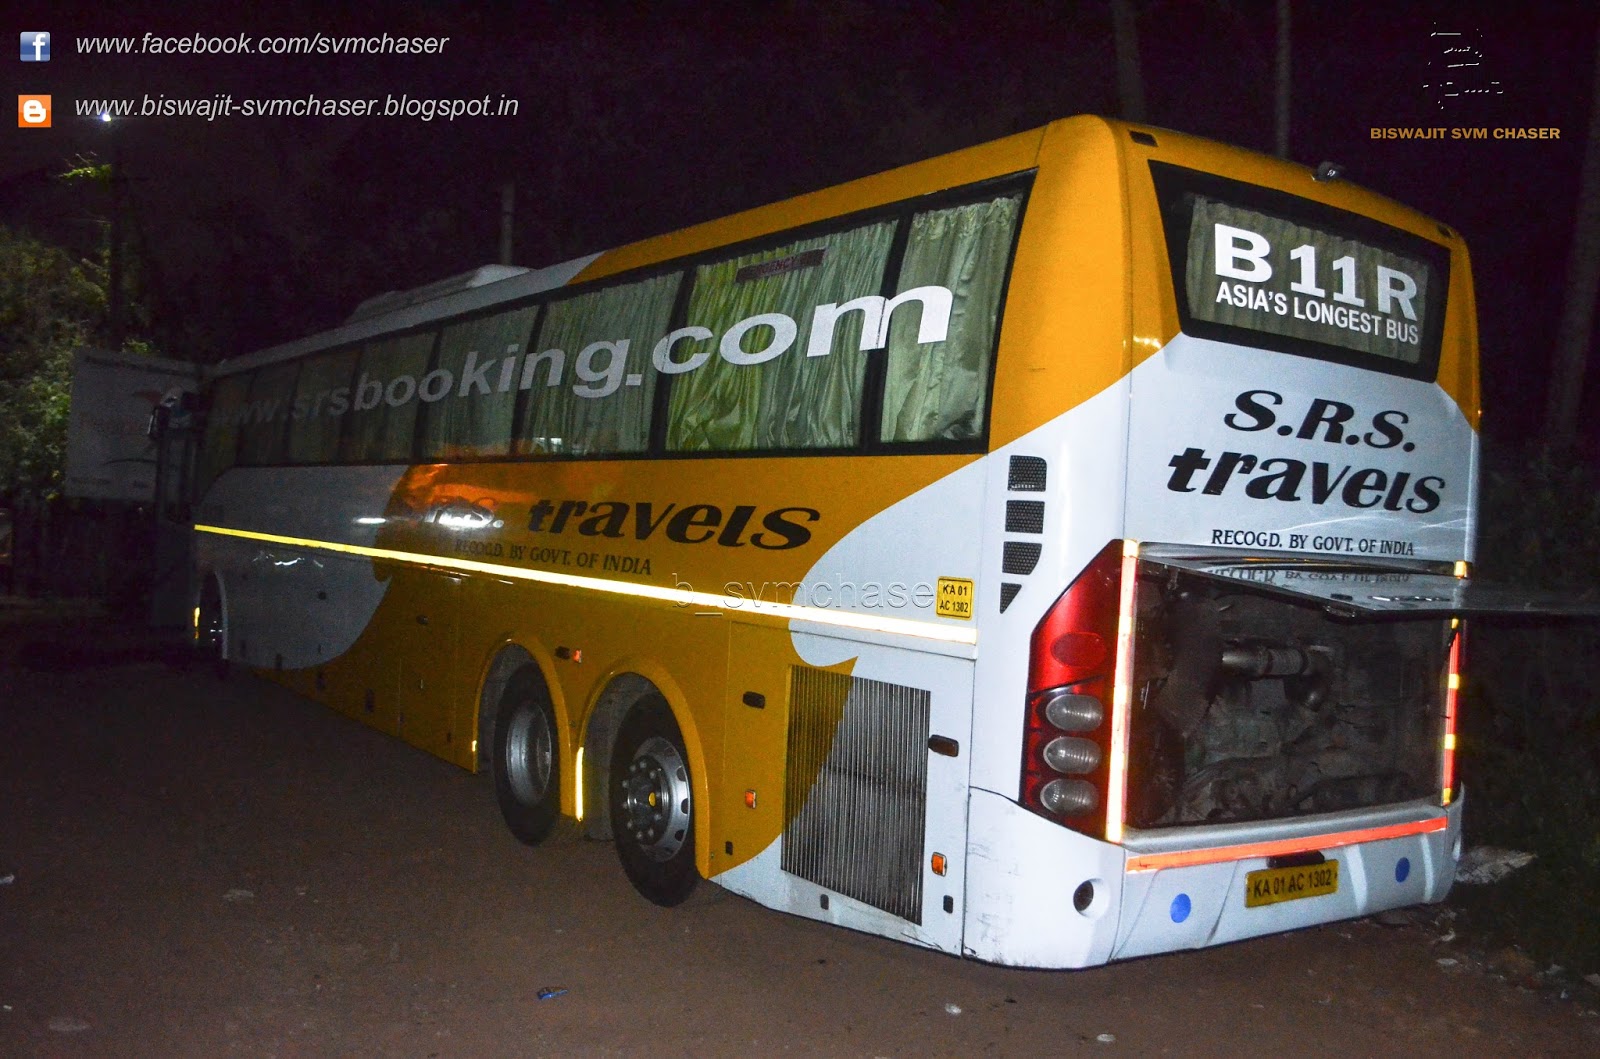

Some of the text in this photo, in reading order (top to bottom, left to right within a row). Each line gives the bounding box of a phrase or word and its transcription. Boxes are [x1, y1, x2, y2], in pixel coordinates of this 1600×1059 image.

[1216, 281, 1419, 345] ASIA'S LONGEST BUS
[211, 285, 953, 425] w.srsbooking.com
[1224, 389, 1415, 452] S.R.S.
[1166, 447, 1446, 514] travels
[528, 500, 821, 550] travels
[1211, 529, 1414, 556] RECOGD. BY GOVT. OF INDIA
[509, 545, 526, 561] BY
[530, 546, 571, 567] GOVT.
[577, 553, 598, 569] OF
[603, 554, 652, 576] INDIA
[939, 600, 969, 613] AC 1302
[943, 585, 967, 595] KA 01
[1254, 869, 1331, 898] KA 01 AC 1302
